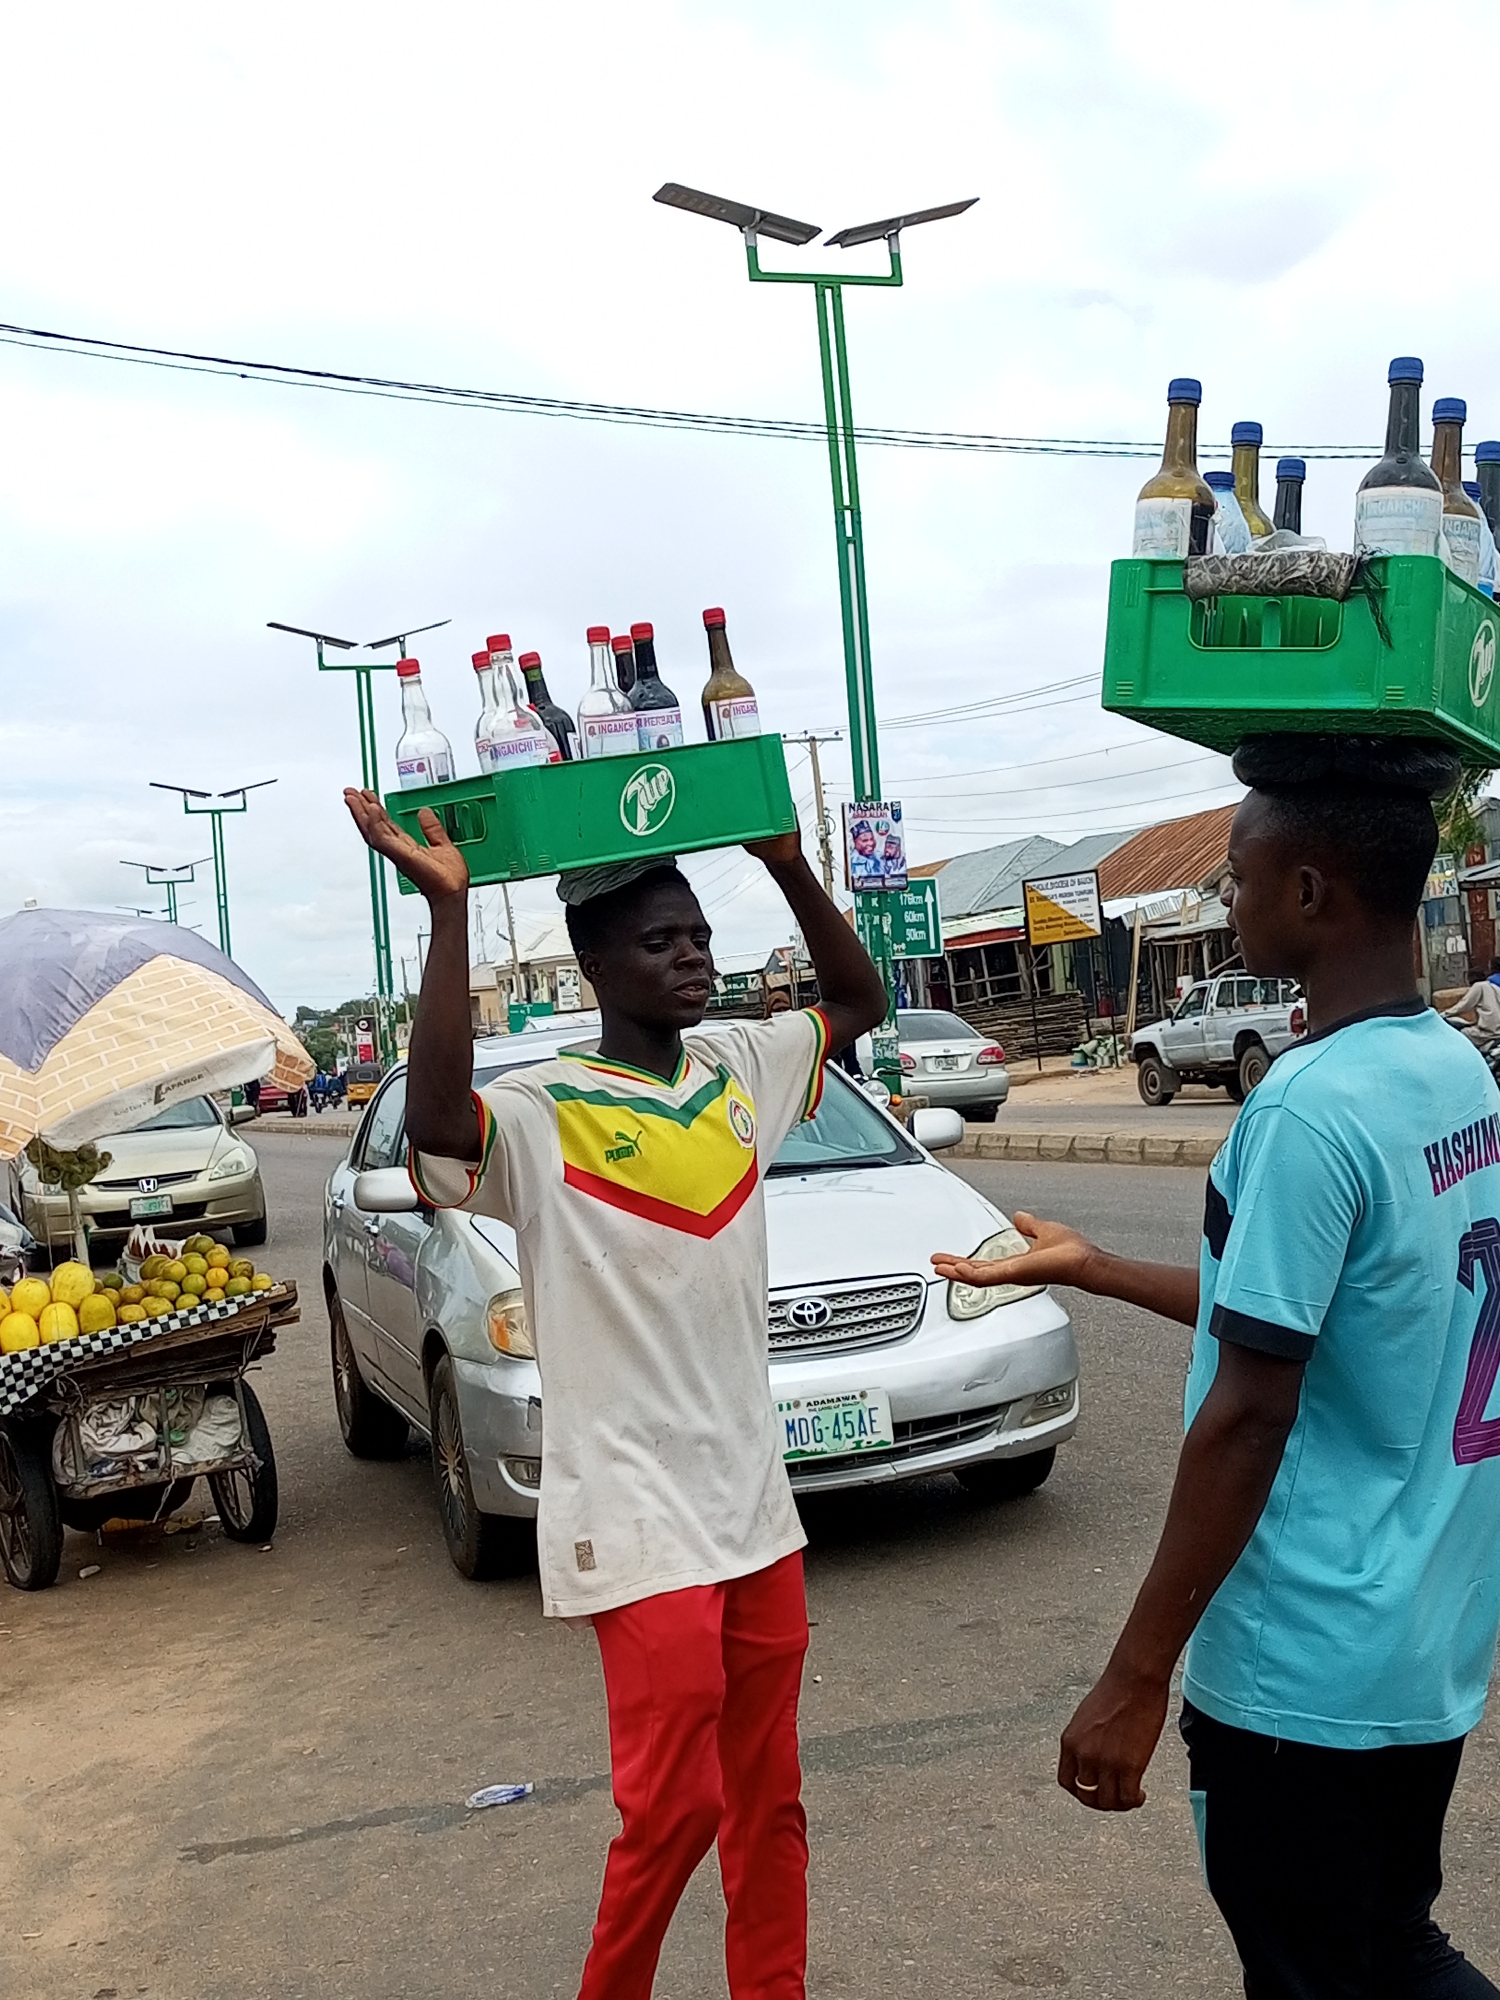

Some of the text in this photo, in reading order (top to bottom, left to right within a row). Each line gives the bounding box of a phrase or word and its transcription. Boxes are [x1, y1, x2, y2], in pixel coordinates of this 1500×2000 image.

[849, 802, 889, 813] NASARA
[904, 911, 925, 923] 60km
[806, 1394, 858, 1408] ADAMAWA
[785, 1407, 881, 1448] MDG-45AE
